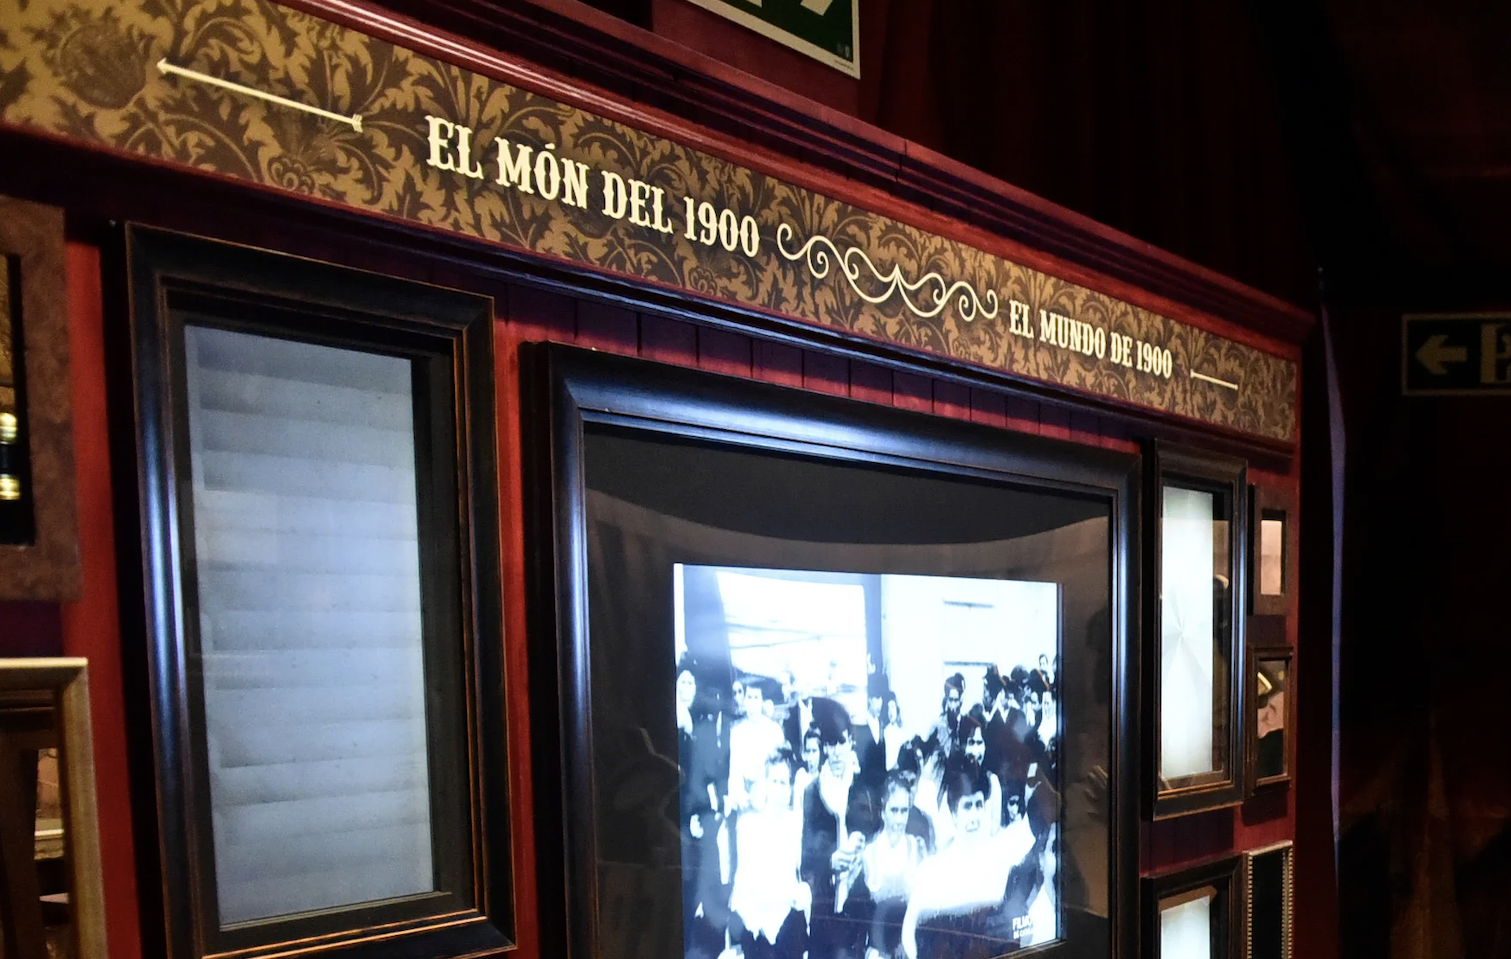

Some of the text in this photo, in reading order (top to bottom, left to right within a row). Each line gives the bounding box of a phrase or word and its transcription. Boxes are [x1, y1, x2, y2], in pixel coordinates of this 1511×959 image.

[424, 114, 761, 258] EL MÓN DEL 1900
[1008, 299, 1174, 379] EL MUNDO DE 1900
